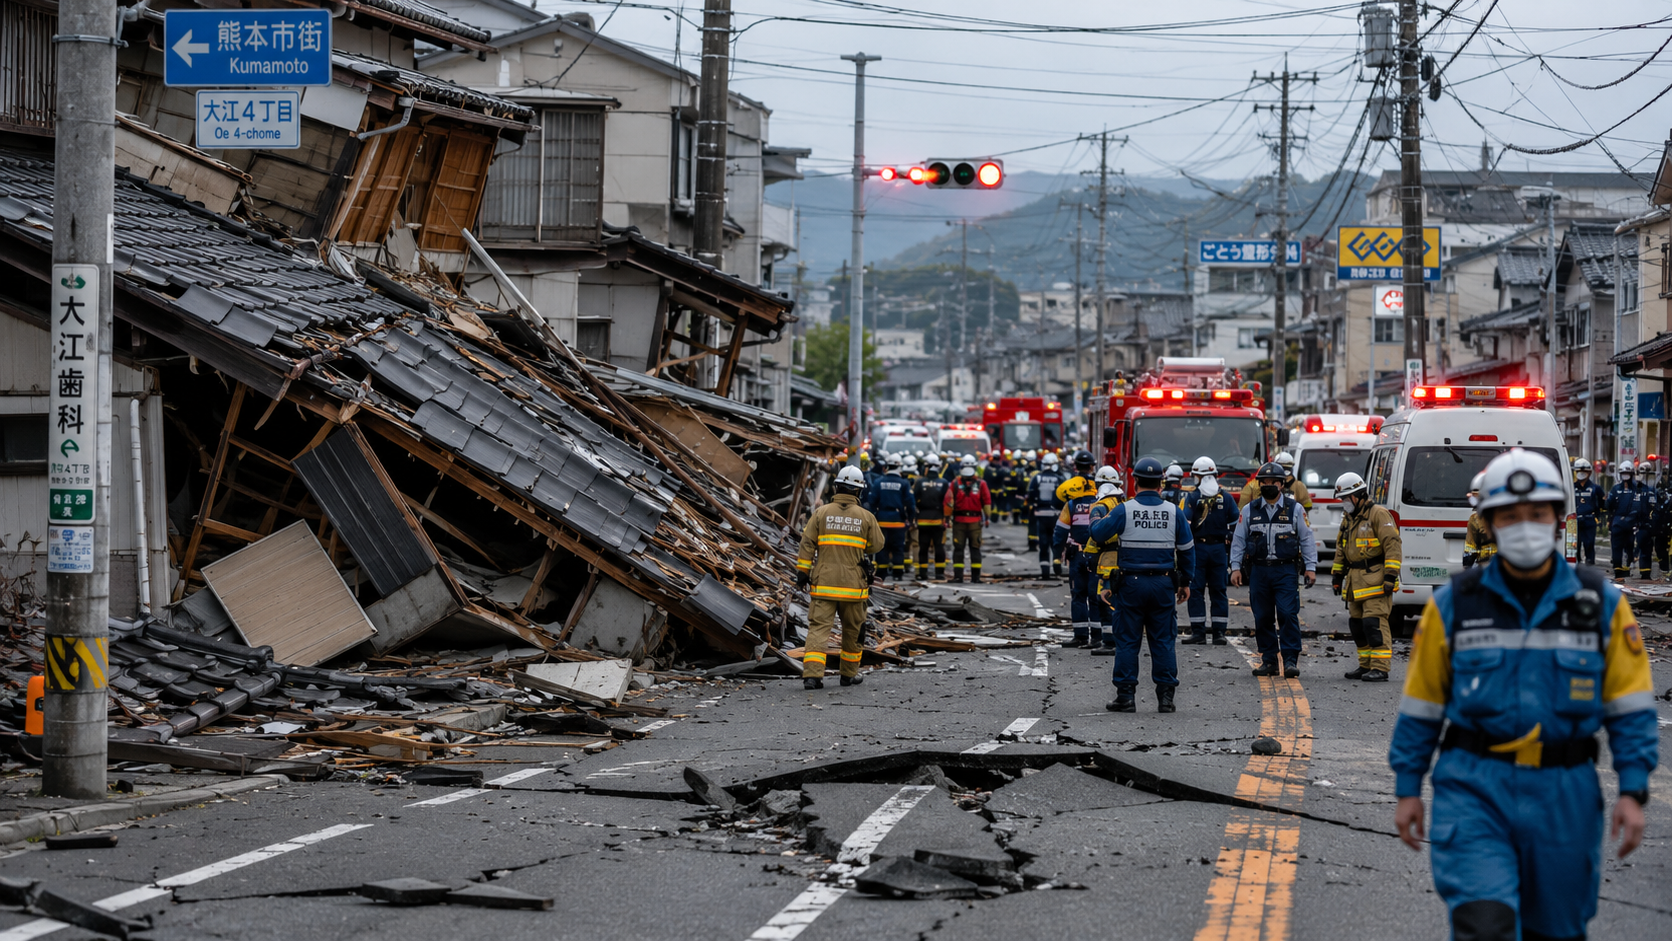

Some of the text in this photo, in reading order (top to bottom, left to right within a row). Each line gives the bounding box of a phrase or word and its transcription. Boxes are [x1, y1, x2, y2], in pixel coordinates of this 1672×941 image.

[217, 20, 323, 52] 熊本市街
[230, 57, 309, 74] Kumamoto
[203, 99, 292, 123] 大江4丁目
[214, 126, 281, 140] Oe 4-chome
[57, 295, 86, 435] 大江歯科
